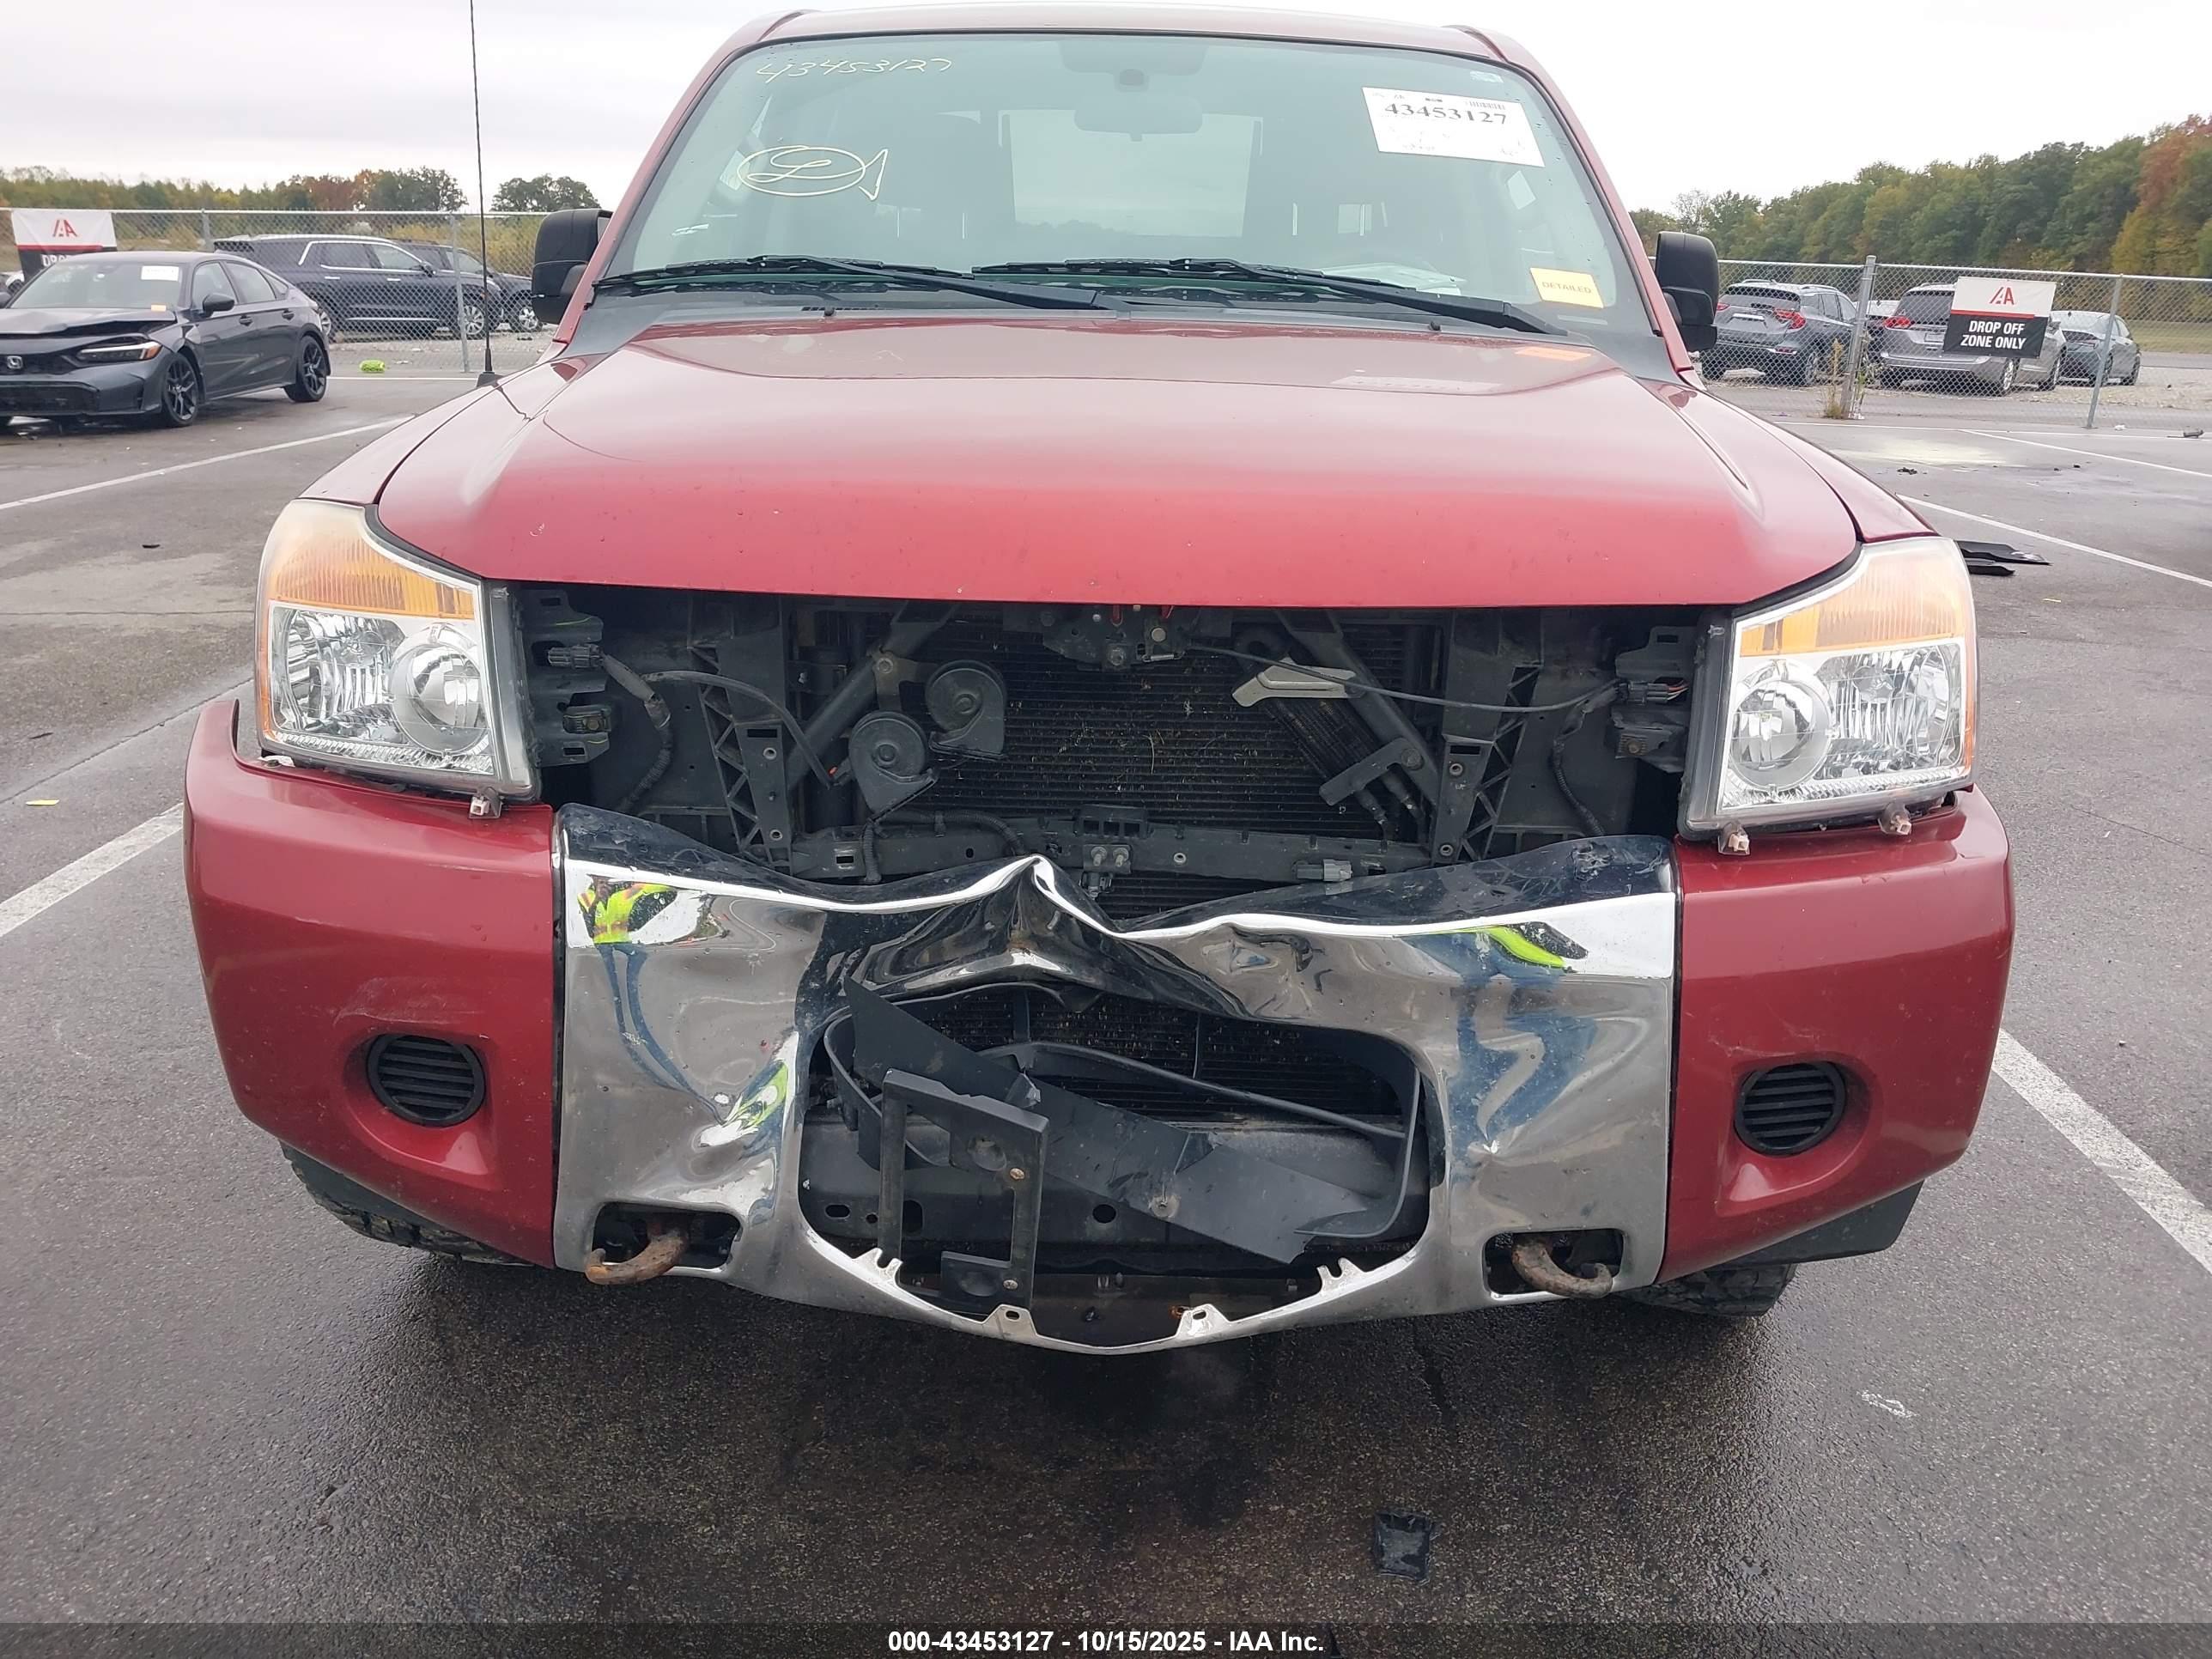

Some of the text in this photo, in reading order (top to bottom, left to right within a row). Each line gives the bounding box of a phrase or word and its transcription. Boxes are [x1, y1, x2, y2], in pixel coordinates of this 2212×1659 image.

[757, 58, 952, 83] 43453127
[1384, 102, 1507, 125] 43453127
[1541, 281, 1592, 295] DETAILED
[1969, 321, 2025, 335] DROP OFF
[1960, 335, 2027, 349] ZONE ONLY
